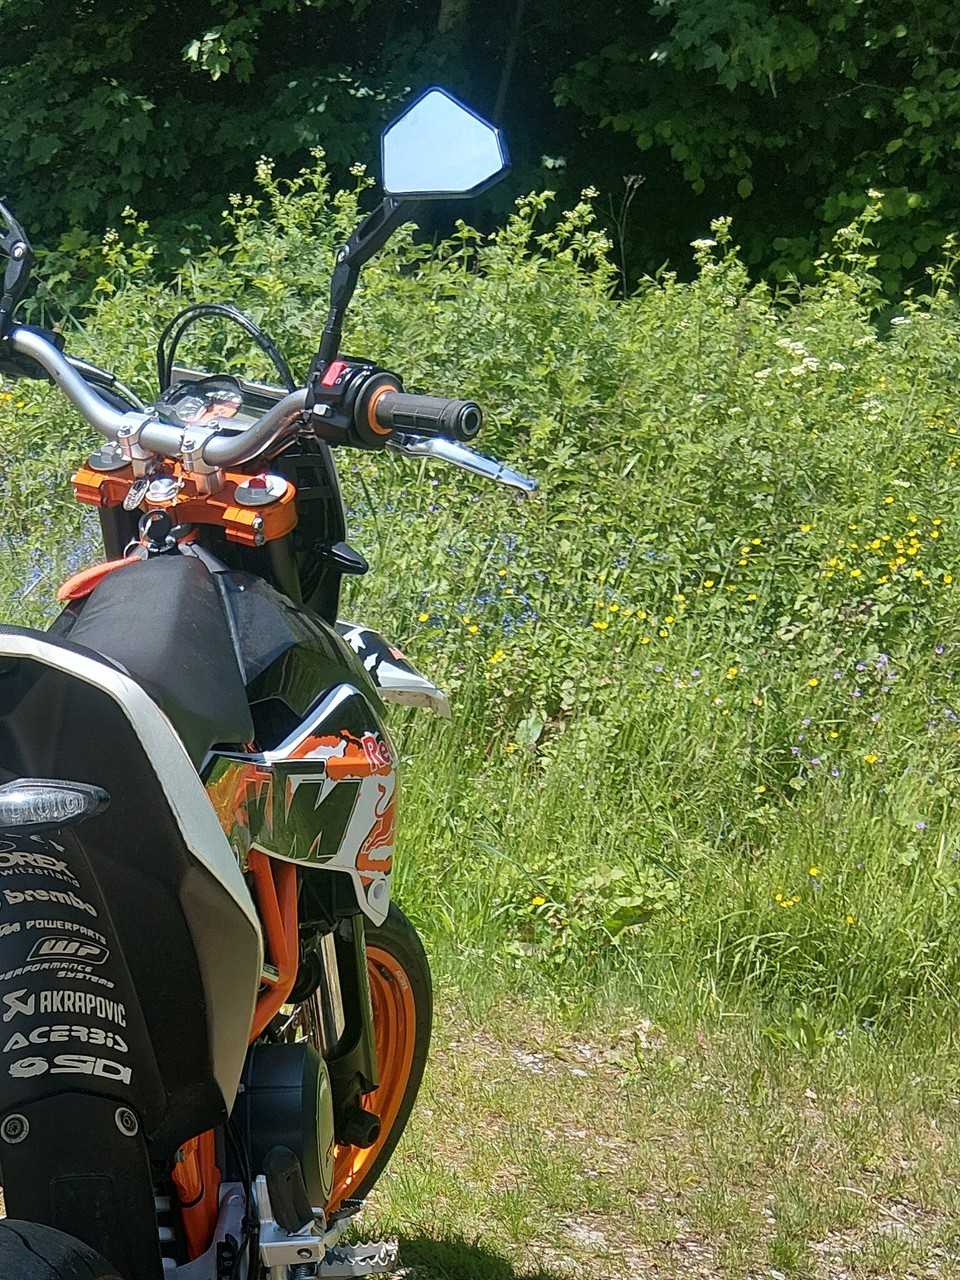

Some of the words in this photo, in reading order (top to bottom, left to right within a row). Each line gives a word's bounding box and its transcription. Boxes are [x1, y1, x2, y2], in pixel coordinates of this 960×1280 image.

[2, 889, 98, 917] brembo
[25, 919, 107, 945] POWERPARTS
[38, 939, 101, 955] WP
[56, 970, 116, 989] SYSTEMS
